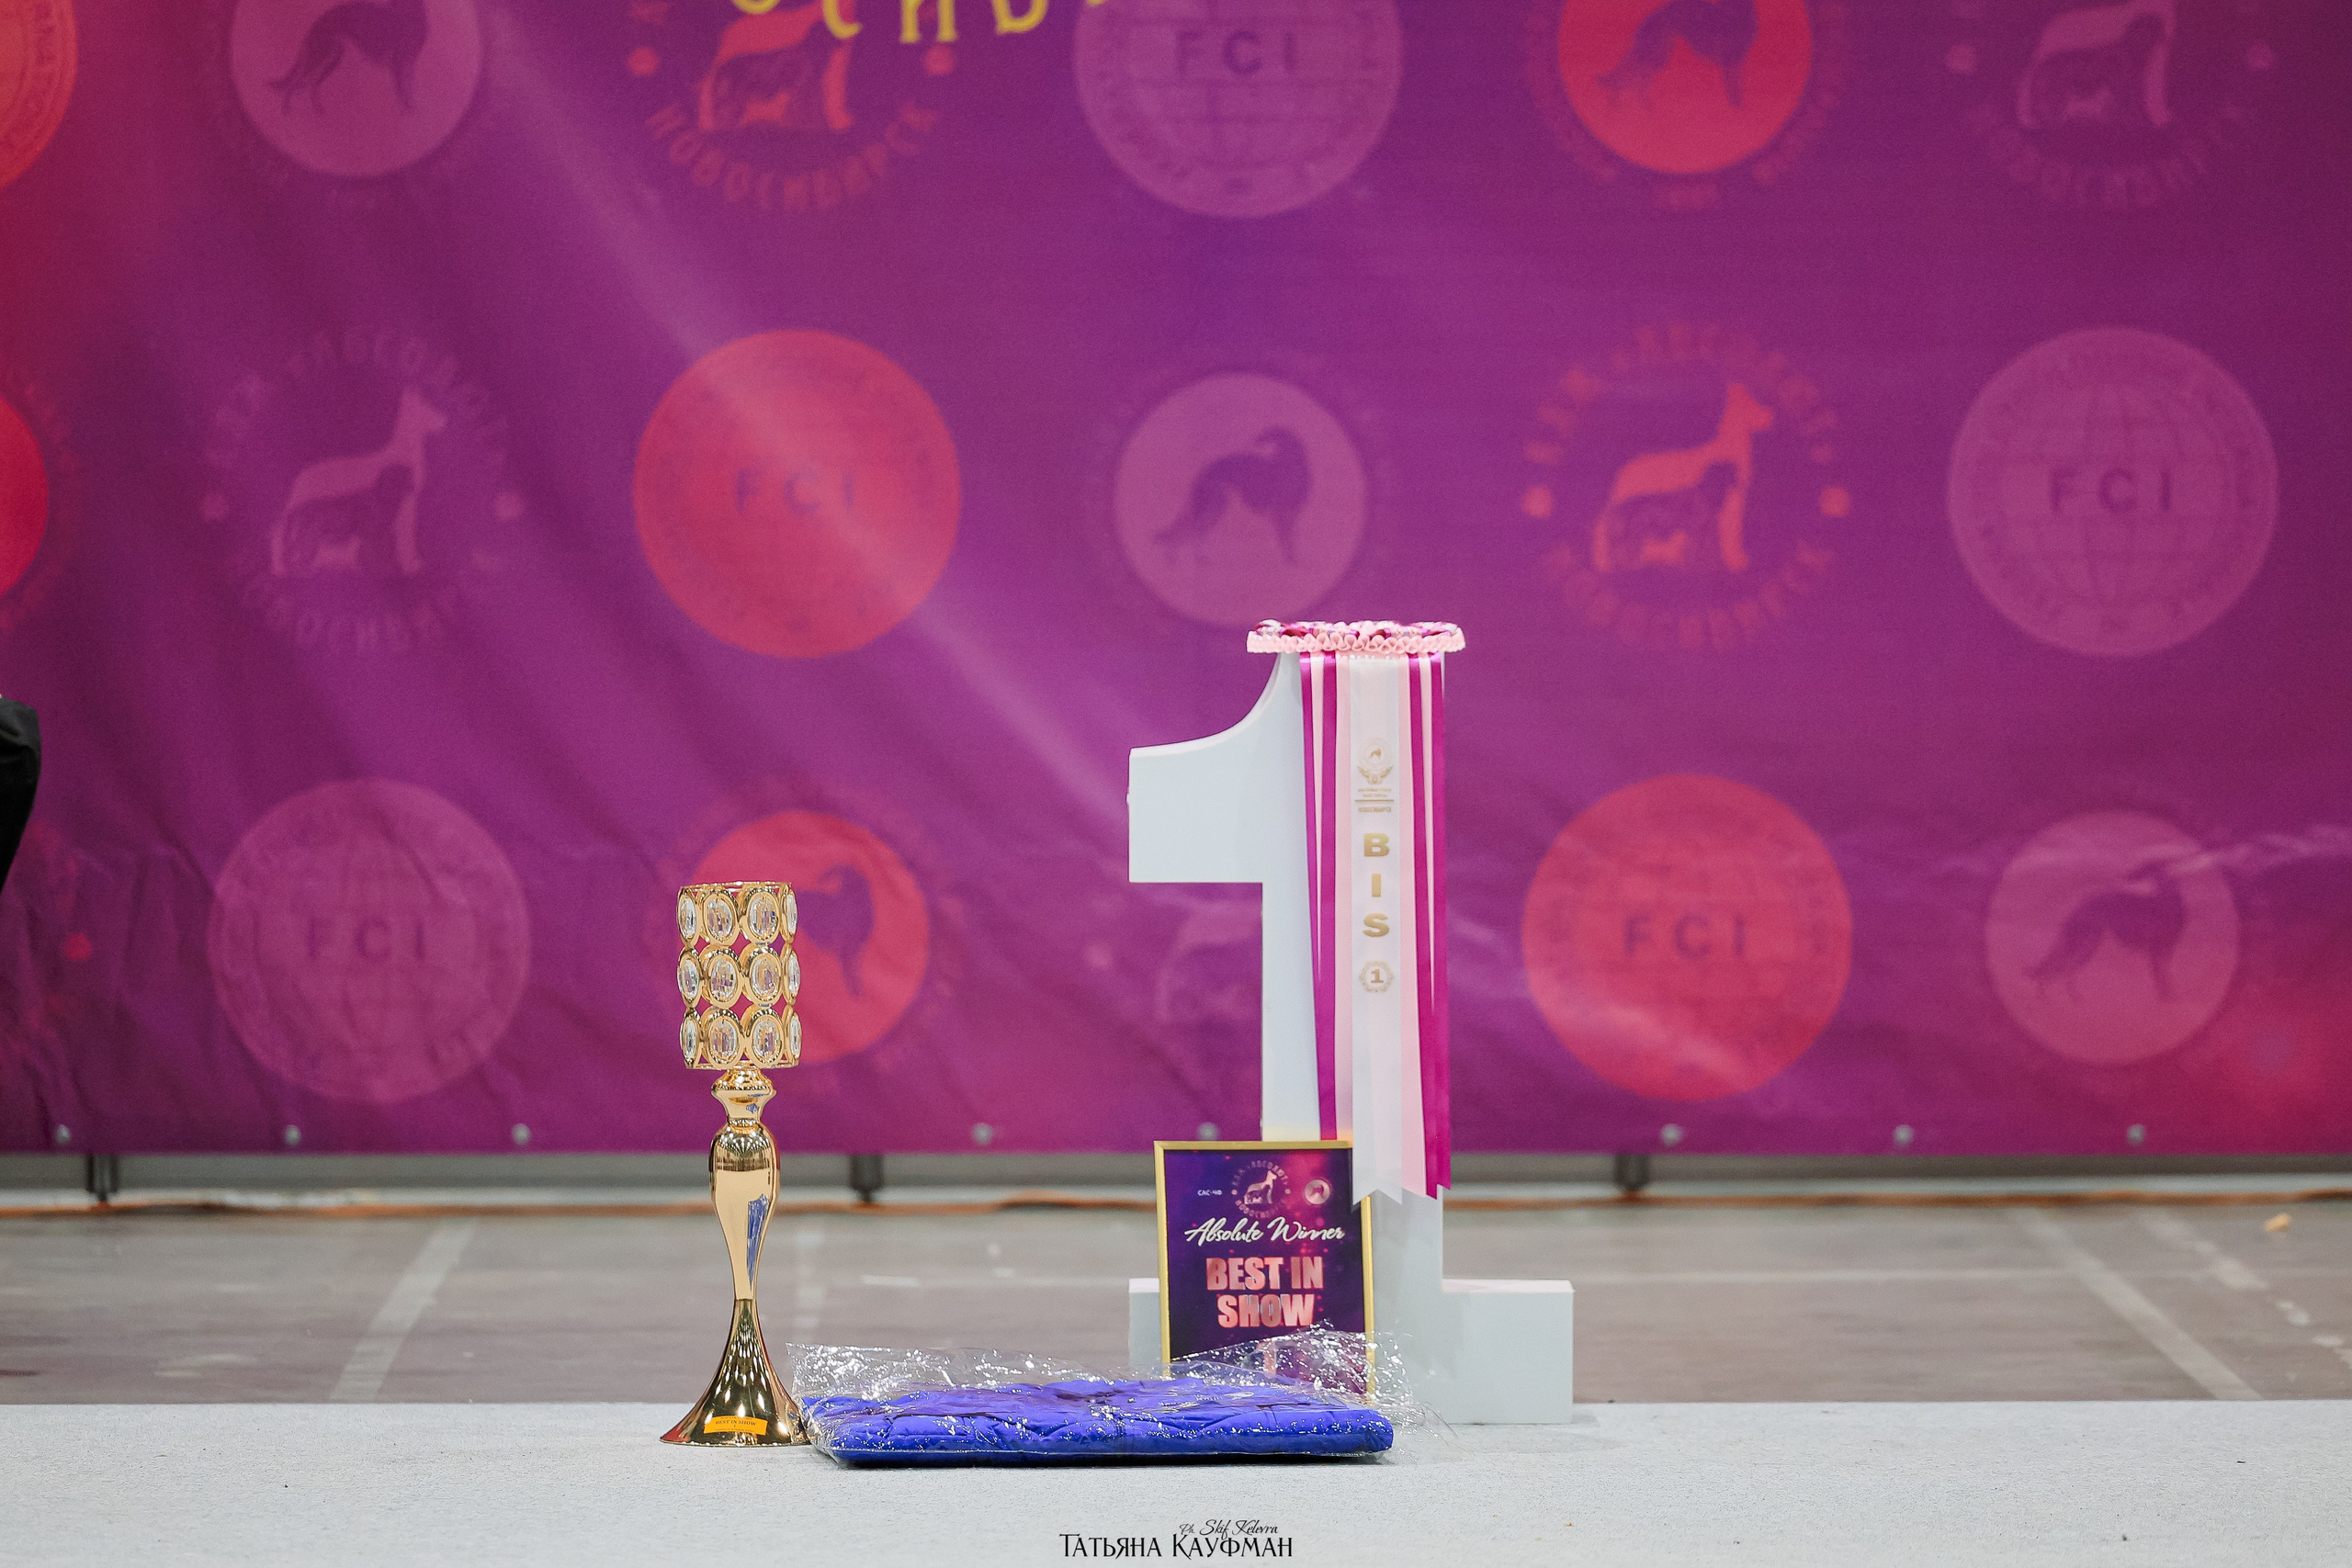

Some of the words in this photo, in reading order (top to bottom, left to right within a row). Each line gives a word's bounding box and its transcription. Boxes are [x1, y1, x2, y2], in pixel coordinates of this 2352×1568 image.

[1176, 29, 1296, 75] FCI
[737, 468, 855, 515] FCI
[2050, 467, 2172, 513] FCI
[1623, 915, 1744, 961] FCI
[1370, 969, 1385, 984] 1
[1184, 1217, 1264, 1247] Absolute
[1267, 1216, 1346, 1242] Winner
[1206, 1257, 1283, 1291] BEST
[1290, 1256, 1324, 1290] IN
[1217, 1293, 1315, 1328] SHOW
